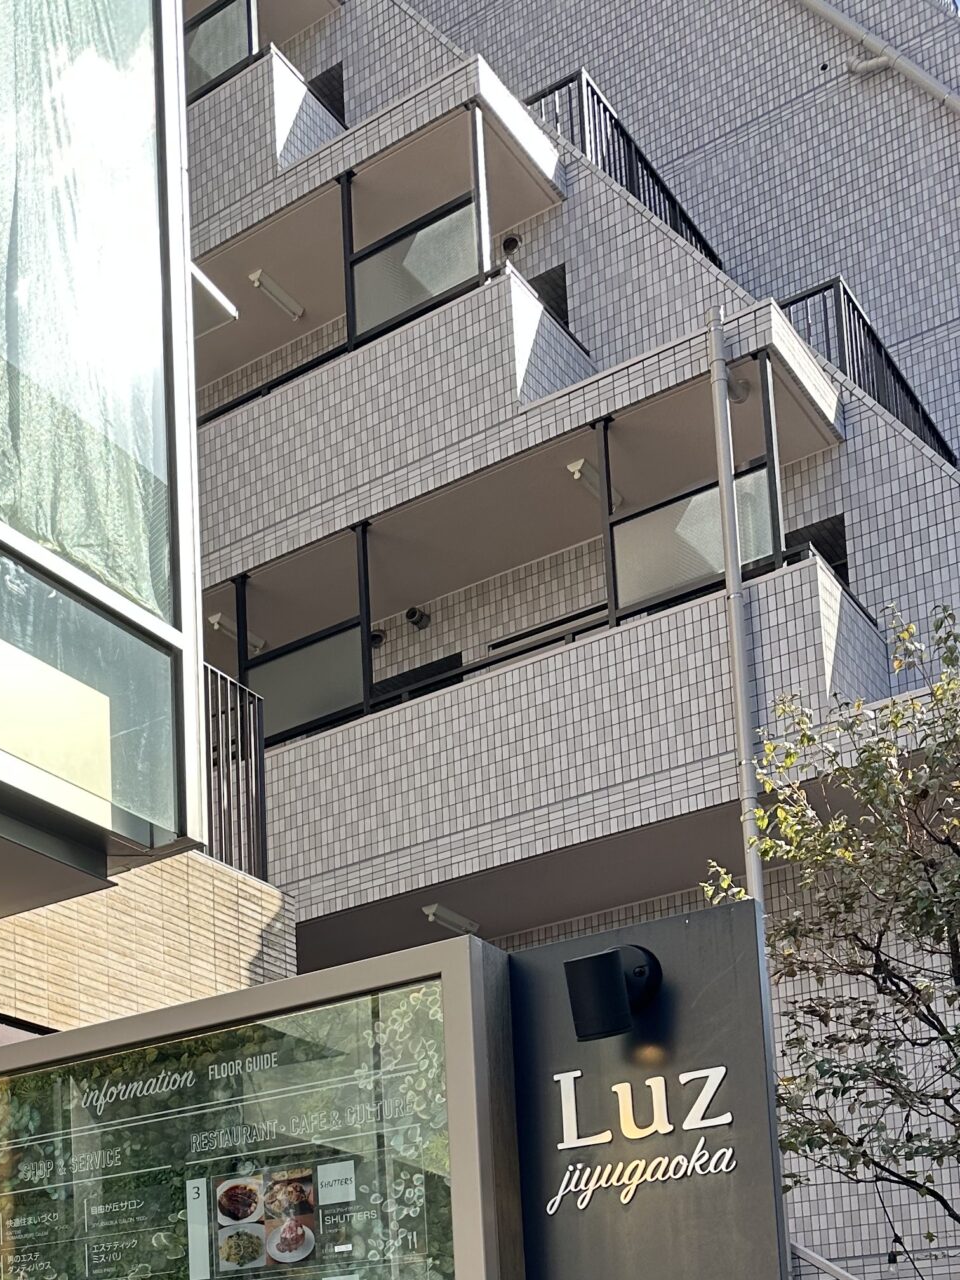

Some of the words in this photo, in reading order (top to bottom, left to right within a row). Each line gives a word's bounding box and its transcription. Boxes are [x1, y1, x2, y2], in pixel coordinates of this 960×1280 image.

[81, 1069, 195, 1115] information
[208, 1060, 242, 1080] FLOOR
[245, 1052, 278, 1070] GUIDE
[553, 1065, 733, 1150] Luz
[191, 1120, 277, 1152] RESTAURANT
[290, 1110, 327, 1136] CAFE
[345, 1098, 416, 1126] CULTURE
[23, 1159, 54, 1181] SHOP
[70, 1148, 121, 1173] SERVICE
[546, 1136, 737, 1216] jiyugaoka
[192, 1186, 201, 1200] 3
[320, 1177, 353, 1189] SHUTTERS
[91, 1200, 145, 1215] 自由が丘サロン
[324, 1210, 377, 1225] SHUTTERS
[92, 1239, 138, 1253] エステティック
